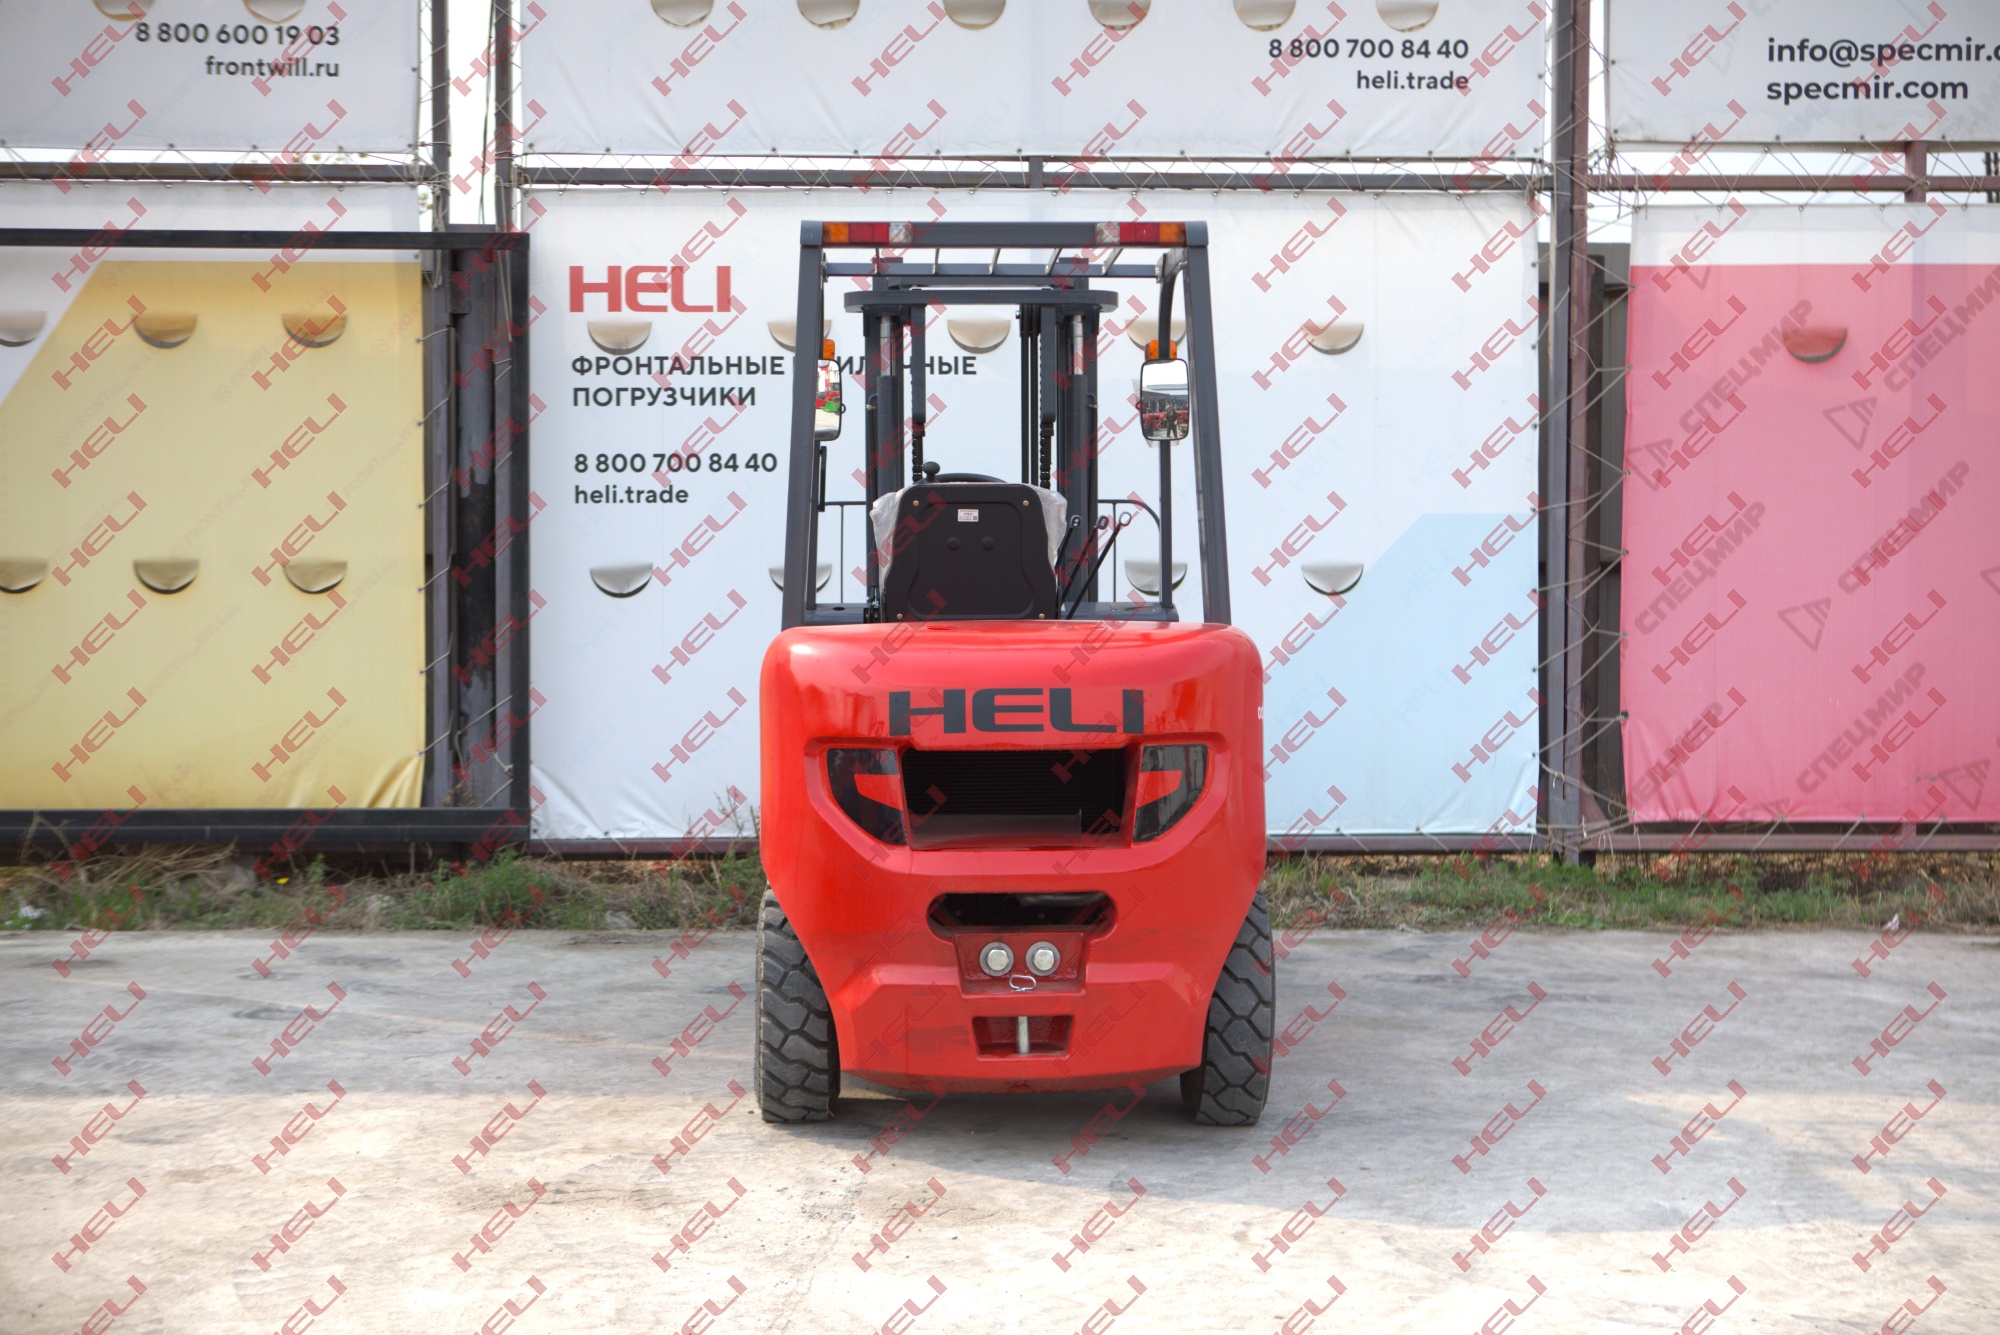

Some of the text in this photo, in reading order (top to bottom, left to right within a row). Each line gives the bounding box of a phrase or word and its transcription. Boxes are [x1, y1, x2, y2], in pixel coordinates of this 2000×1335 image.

[136, 22, 340, 46] 8 800 600 19 03
[1269, 39, 1469, 59] 8 800 700 84 40
[205, 55, 340, 77] frontwill.ru
[1356, 70, 1469, 90] heli.trade
[1767, 75, 1969, 106] specmir.com
[569, 265, 731, 313] HELI
[1882, 264, 2000, 393] СПЕЦМИ
[571, 355, 785, 376] ФРОНТАЛЬНЫЕ
[573, 386, 756, 407] ПОГРУЗЧИКИ
[574, 453, 778, 474] 8 800 700 84 40
[574, 484, 690, 504] heli.trade
[1634, 501, 1766, 635] СПЕЦМИР
[889, 687, 1145, 737] HELI
[1796, 661, 1926, 795] СПЕЦМИР
